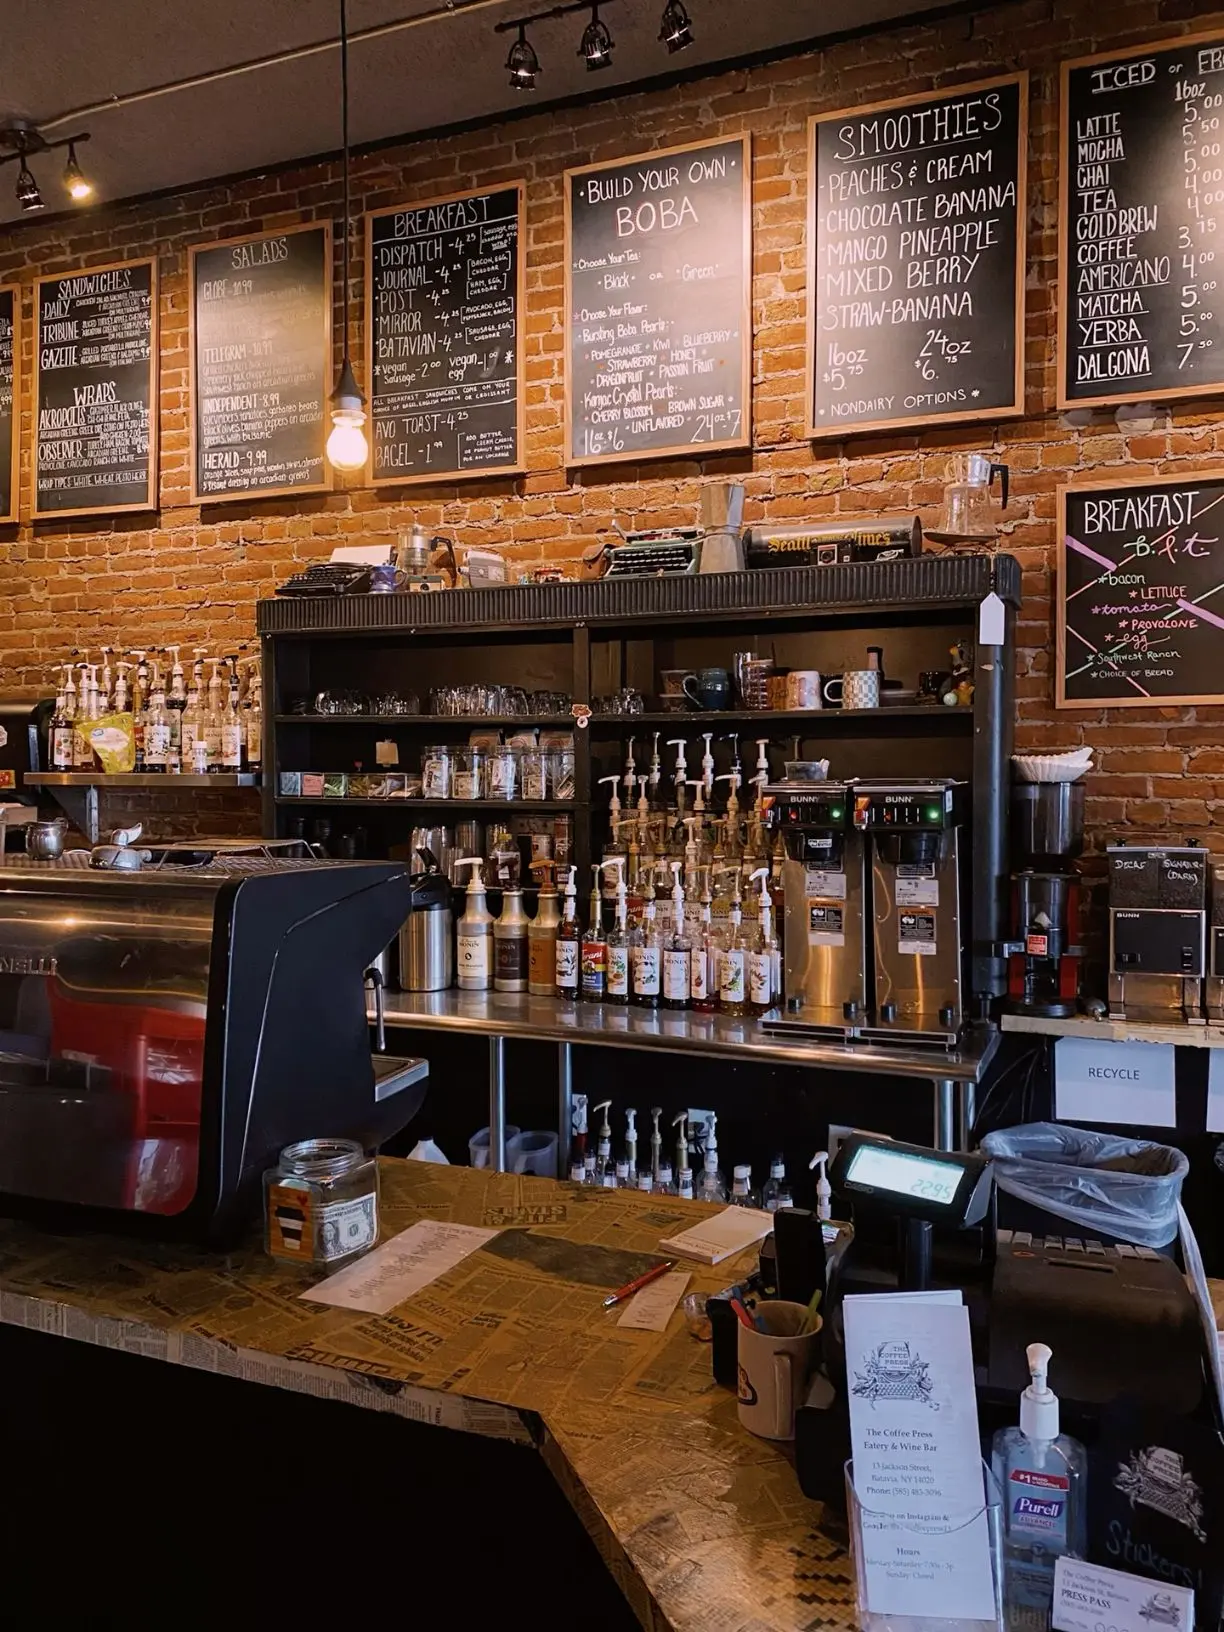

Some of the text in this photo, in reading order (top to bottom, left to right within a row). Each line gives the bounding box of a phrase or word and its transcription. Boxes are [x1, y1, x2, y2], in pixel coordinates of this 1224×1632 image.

[1091, 62, 1184, 91] ICED or
[1175, 80, 1206, 101] 16oz
[833, 93, 1002, 160] SMOOTHIES
[1077, 112, 1121, 139] LATTE
[1078, 137, 1124, 163] MOCHA
[588, 156, 726, 204] BUILD YOUR OWN
[828, 161, 903, 203] PEACHES
[926, 149, 993, 184] CREAM
[1077, 164, 1110, 188] CHAI
[826, 181, 1016, 233] CHOCOLATE BANANA
[1078, 189, 1117, 213] TEA
[394, 196, 490, 238] BREAKFAST
[616, 196, 699, 237] BOBA
[231, 238, 288, 268] SALADS
[380, 237, 443, 267] DISPATCH
[827, 219, 999, 266] MANGO PINEAPPLE
[1077, 236, 1137, 264] COFFEE
[58, 269, 131, 300] SANDWICHES
[378, 265, 433, 290] JOURNAL
[826, 253, 980, 296] MIXED BERRY
[1077, 256, 1170, 292] AMERICANO
[44, 300, 71, 318] DAILY
[380, 288, 417, 313] POST
[822, 291, 973, 331] STRAW-BANANA
[1079, 291, 1143, 318] MATCHA
[379, 311, 422, 335] MIRROR
[580, 305, 624, 322] Choose Your
[43, 321, 79, 344] TRIBUNE
[582, 326, 615, 347] Bursting
[617, 322, 637, 338] Boba
[683, 329, 731, 348] BLUEBERRY
[1079, 318, 1142, 345] YERBA
[378, 331, 437, 358] BATAVIAN
[828, 329, 972, 367] 16oz 24oz
[41, 346, 78, 369] GAZETTE
[382, 352, 477, 377] Vegan vegan
[607, 348, 697, 373] STRAWBERRY HONEY
[659, 363, 689, 380] PASSION
[692, 358, 715, 374] FRUIT
[1077, 346, 1150, 380] DALGONA
[384, 368, 465, 387] Sausage egg
[73, 381, 117, 406] WRAPS
[831, 389, 967, 417] NONDAIRY OPTIONS
[39, 406, 86, 430] AKROPOLIS
[591, 394, 725, 424] CHERRY BLOSSOM BROWN SUGAR
[376, 414, 442, 440] AVO TOAST
[631, 415, 685, 434] UNFLAVORED
[38, 441, 82, 461] OBSERVER
[203, 451, 240, 469] HERALD
[375, 442, 414, 469] BAGEL
[1085, 491, 1200, 534] BREAKFAST
[1108, 572, 1146, 585] bacon
[1141, 586, 1187, 600] LETTUCE
[1101, 602, 1172, 615] tomato
[1132, 619, 1198, 629] PROVOLONE
[1116, 633, 1171, 651] egg
[1097, 650, 1181, 664] Southwest Ranch
[1099, 670, 1127, 678] CHOICE
[1145, 669, 1174, 677] BREAD
[1088, 1067, 1140, 1081] RECYCLE
[866, 1428, 933, 1438] The Coffee Press
[864, 1441, 938, 1452] Eatery & Wine Bar
[1020, 1498, 1059, 1517] Purell
[896, 1547, 921, 1556] Hours
[1061, 1589, 1087, 1602] PRESS
[1090, 1596, 1112, 1609] PASS
